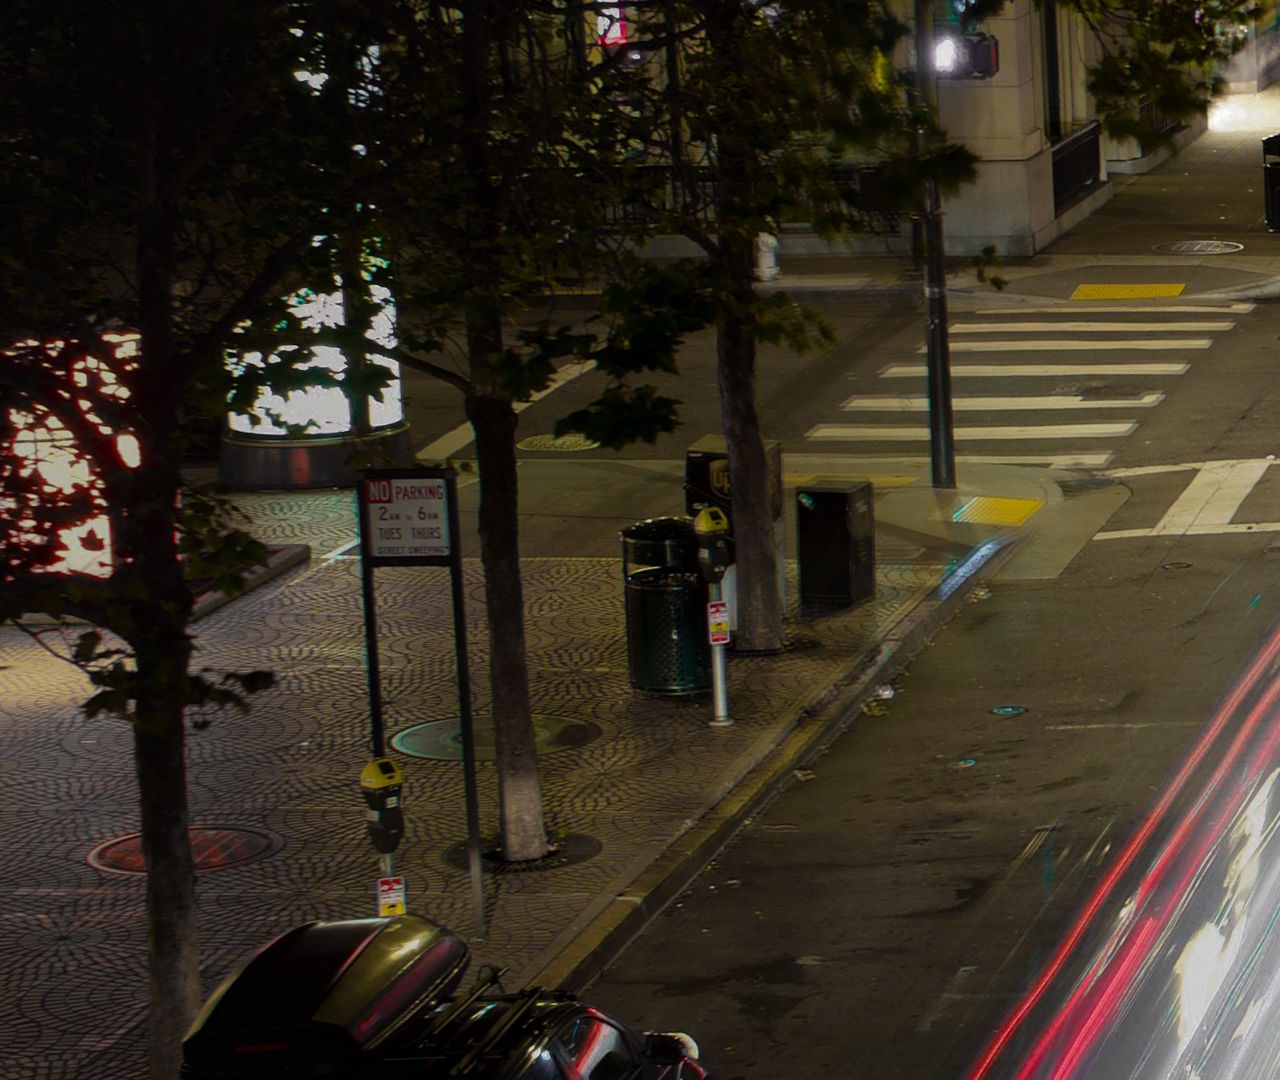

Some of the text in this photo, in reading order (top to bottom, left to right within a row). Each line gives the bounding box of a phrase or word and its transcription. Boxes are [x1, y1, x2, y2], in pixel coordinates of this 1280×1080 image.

[368, 480, 444, 501] NO PARKING
[379, 527, 442, 540] TUES THURS
[378, 546, 445, 555] STREET SWEEPING
